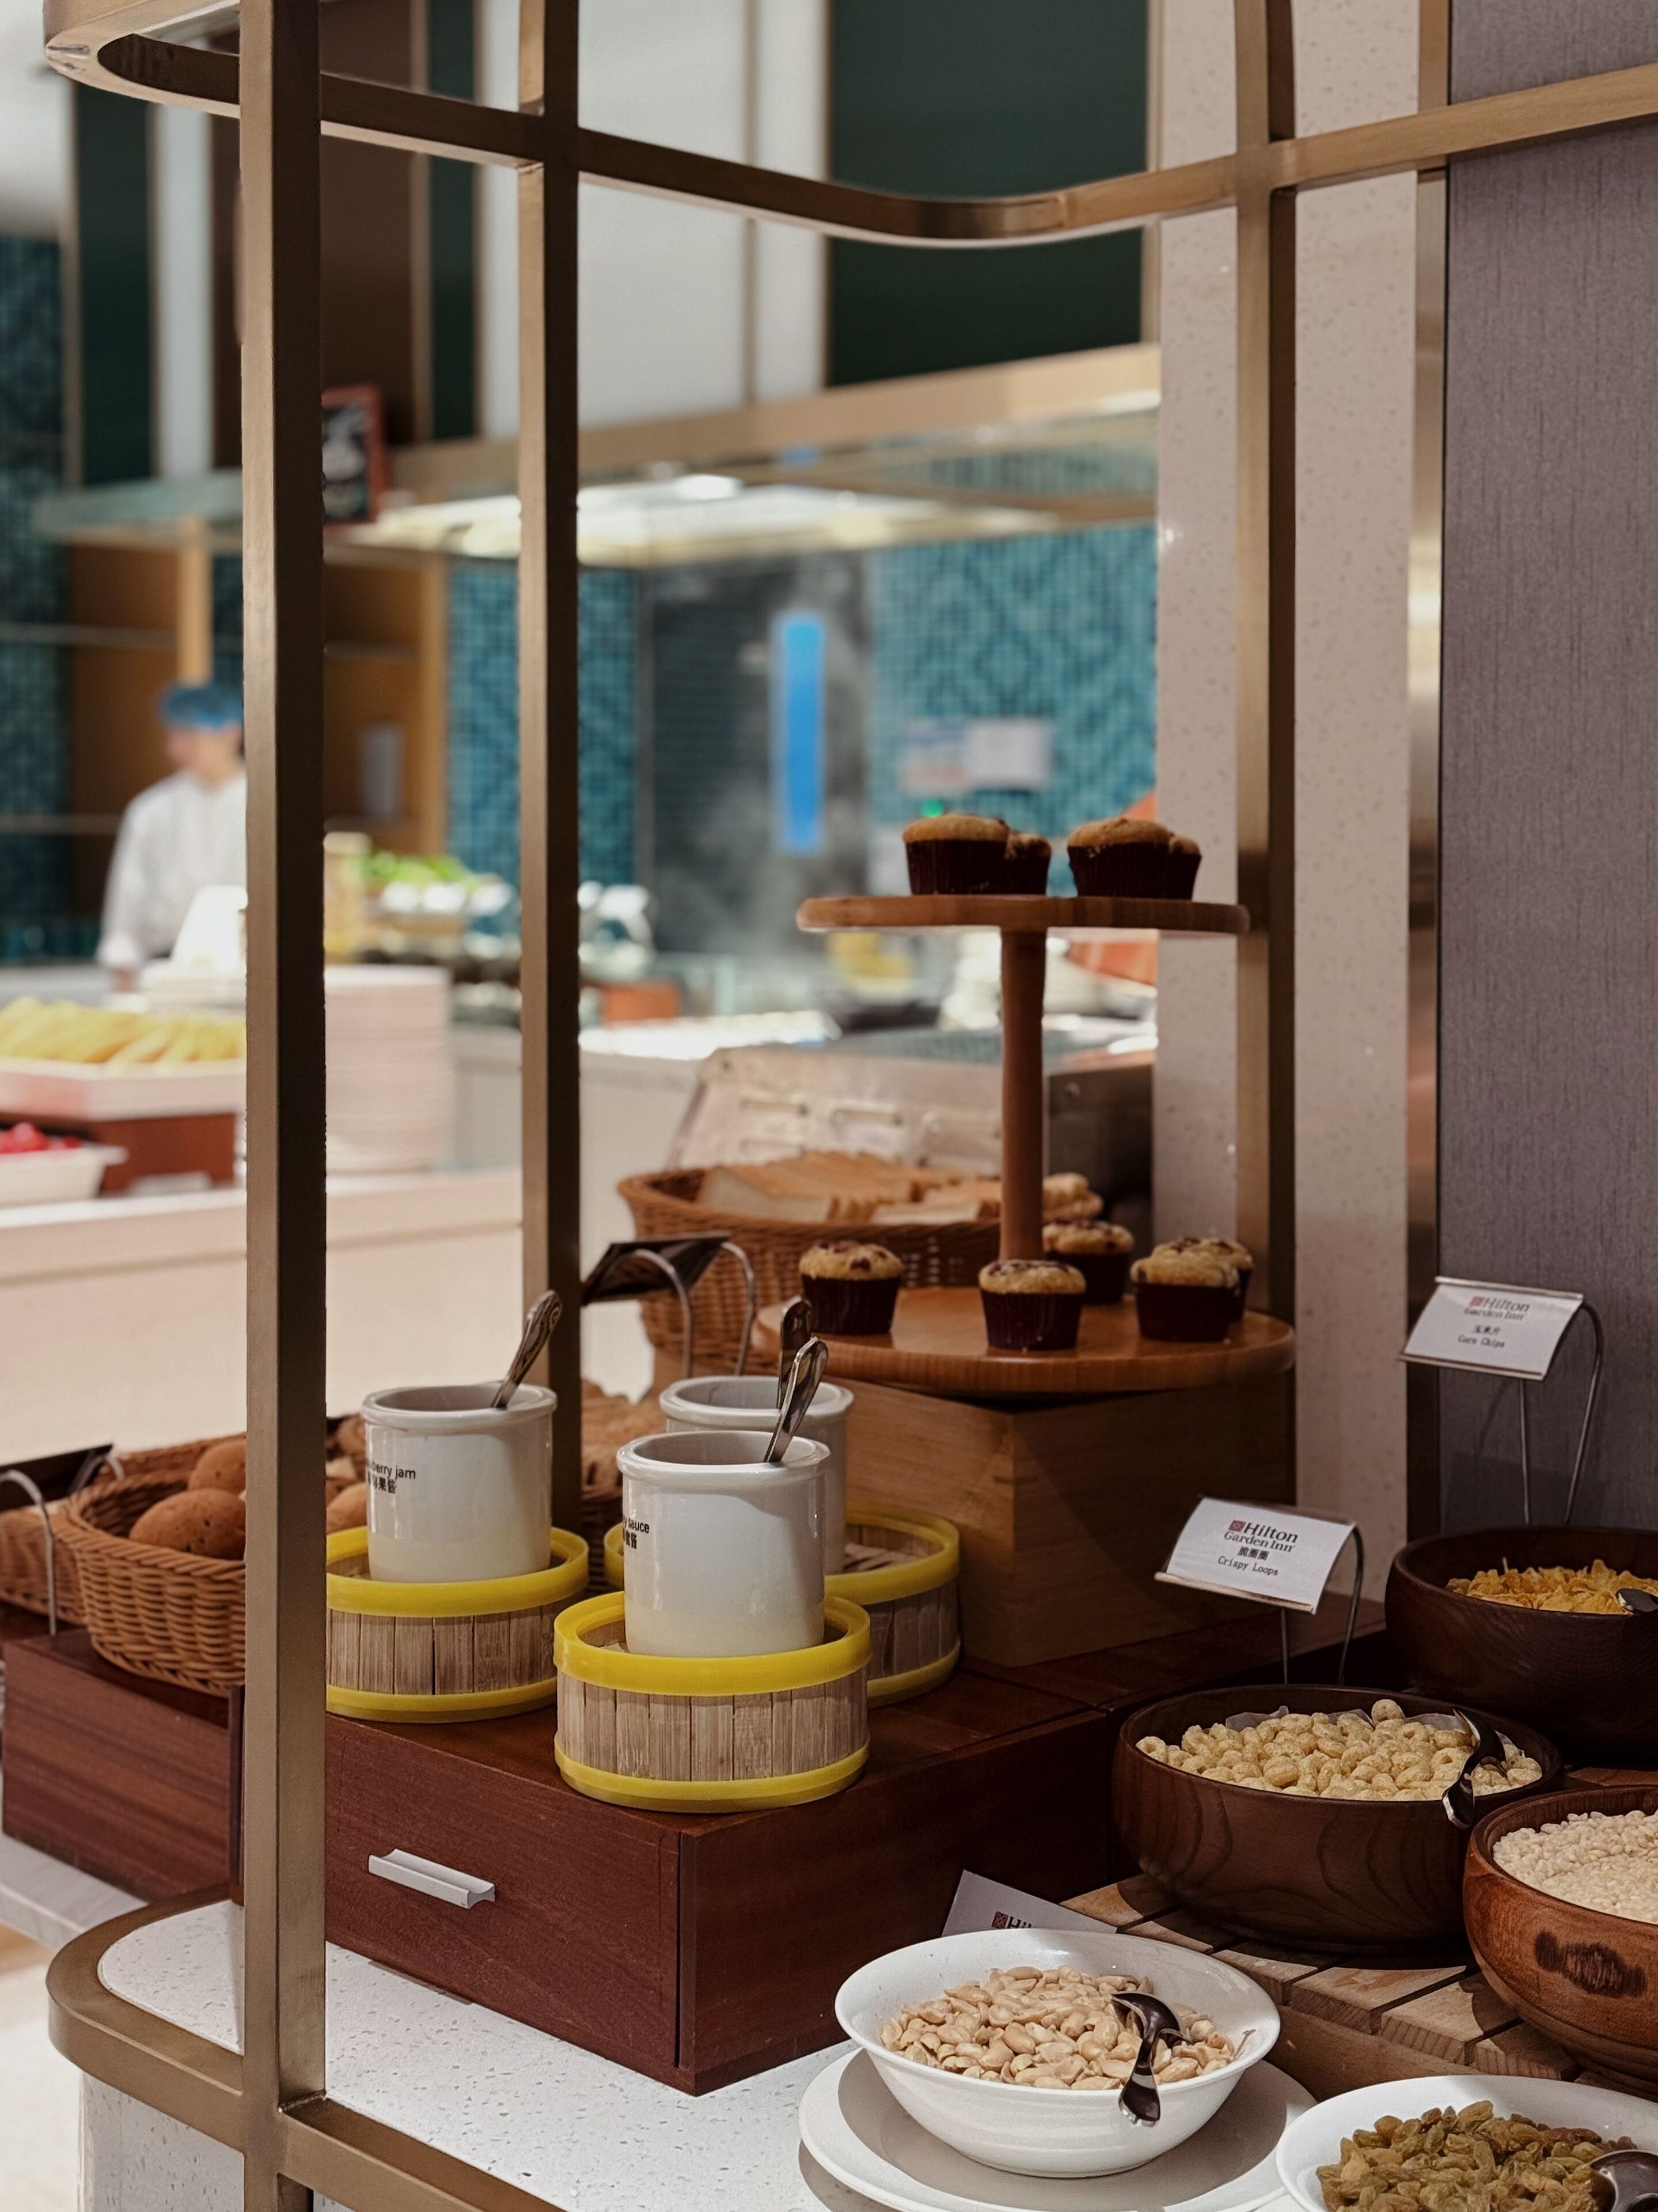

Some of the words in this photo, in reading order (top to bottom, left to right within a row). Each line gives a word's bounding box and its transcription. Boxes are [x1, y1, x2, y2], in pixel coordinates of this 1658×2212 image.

[1483, 1297, 1530, 1312] Hilton
[1464, 1308, 1503, 1319] Garden
[1504, 1310, 1525, 1320] Inn
[1458, 1335, 1477, 1344] Corn
[1481, 1338, 1505, 1348] Chips
[395, 1465, 416, 1479] jam
[1243, 1522, 1298, 1544] Hilton
[1224, 1531, 1269, 1547] Garden
[1270, 1540, 1293, 1552] Inn
[1218, 1555, 1249, 1570] Crispy
[1253, 1562, 1279, 1576] Loops
